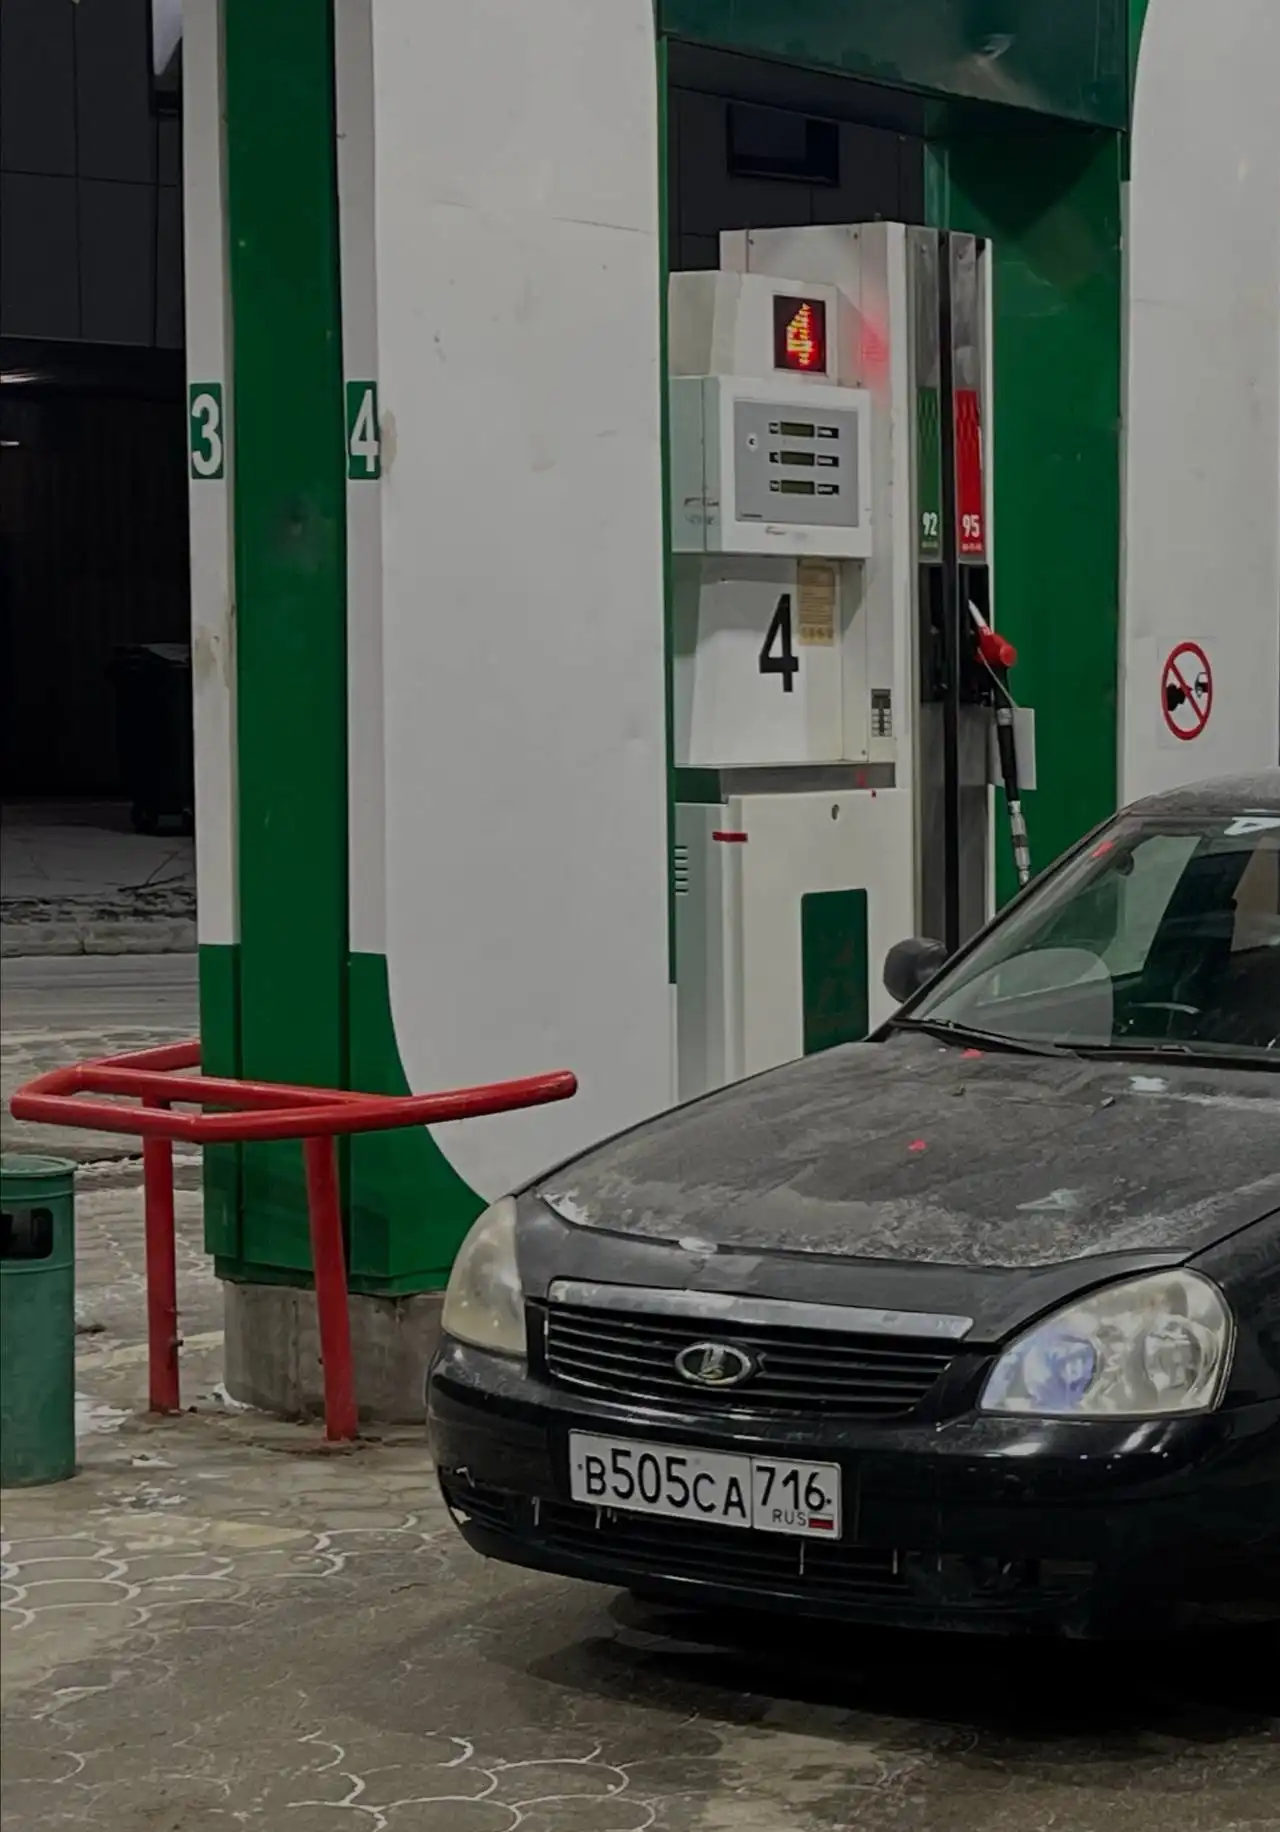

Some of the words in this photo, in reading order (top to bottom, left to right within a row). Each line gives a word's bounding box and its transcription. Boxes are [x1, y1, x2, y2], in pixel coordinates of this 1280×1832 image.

[785, 302, 815, 366] 4
[192, 393, 222, 476] 3
[350, 388, 379, 472] 4
[922, 511, 938, 537] 92
[962, 513, 981, 538] 95
[759, 593, 799, 692] 4
[756, 1465, 826, 1511] 716
[772, 1508, 807, 1526] RUS
